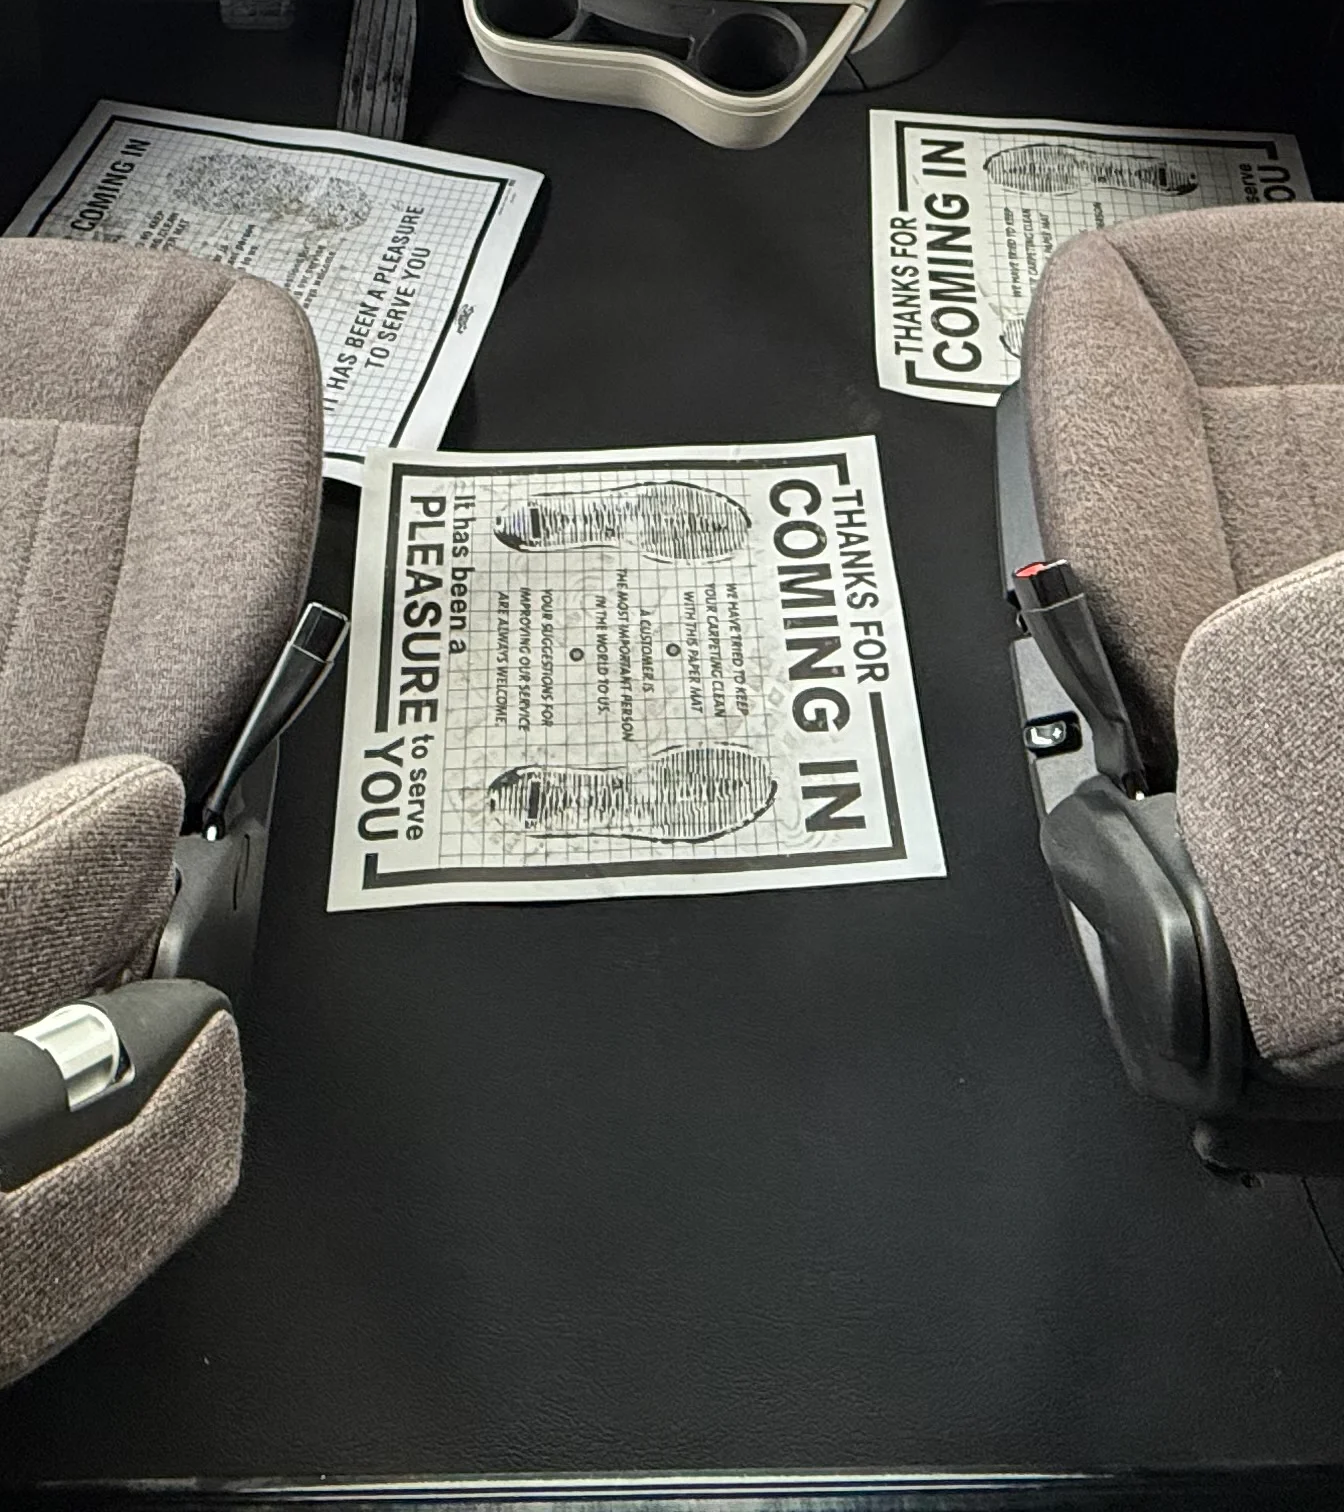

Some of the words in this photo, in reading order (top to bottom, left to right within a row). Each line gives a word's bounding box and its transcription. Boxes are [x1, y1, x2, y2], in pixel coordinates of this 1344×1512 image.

[920, 137, 967, 178] IN
[70, 160, 135, 231] COMING
[120, 138, 151, 157] IN
[1257, 164, 1296, 203] OU
[372, 205, 425, 284] PLEASURE
[890, 217, 919, 259] FOR
[367, 289, 387, 301] A
[924, 192, 982, 372] COMING
[344, 301, 380, 348] BEEN
[364, 346, 390, 368] TO
[377, 286, 416, 342] SERVE
[401, 247, 431, 280] YOU
[891, 265, 924, 356] THANKS
[326, 353, 358, 390] HAS
[454, 494, 476, 510] It
[452, 517, 476, 559] has
[832, 489, 879, 609] THANKS
[449, 566, 476, 630] been
[617, 568, 629, 589] THE
[705, 583, 718, 612] YOUR
[726, 583, 738, 599] WE
[398, 495, 446, 726] PLEASURE
[497, 591, 509, 614] ARE
[519, 587, 532, 654] IMPROVING
[541, 589, 553, 619] YOUR
[595, 595, 606, 608] IN
[595, 610, 607, 630] THE
[617, 591, 630, 622] MOST
[683, 591, 697, 620] WITH
[728, 602, 742, 632] HAVE
[769, 478, 851, 733] COMING
[449, 639, 466, 655] a
[497, 617, 509, 664] ALWAYS
[640, 620, 654, 679] CUSTOMER
[685, 622, 698, 646] THIS
[706, 615, 723, 678] CARPETING
[731, 635, 744, 666] TRIED
[849, 620, 890, 685] FOR
[519, 656, 531, 682] OUR
[541, 623, 553, 701] SUGGESTIONS
[596, 633, 609, 676] WORLD
[618, 624, 632, 691] IMPORTANT
[687, 649, 701, 683] PAPER
[597, 678, 609, 694] TO
[642, 682, 655, 692] IS
[733, 669, 746, 684] TO
[495, 666, 509, 728] WELCOME.
[518, 684, 531, 732] SERVICE
[541, 702, 553, 728] FOR
[689, 686, 703, 714] MAT
[712, 680, 727, 718] CLEAN
[735, 686, 749, 716] KEEP
[620, 694, 634, 742] PERSON
[411, 734, 435, 760] to
[357, 736, 406, 842] YOU
[406, 767, 427, 841] serve
[798, 759, 867, 833] IN
